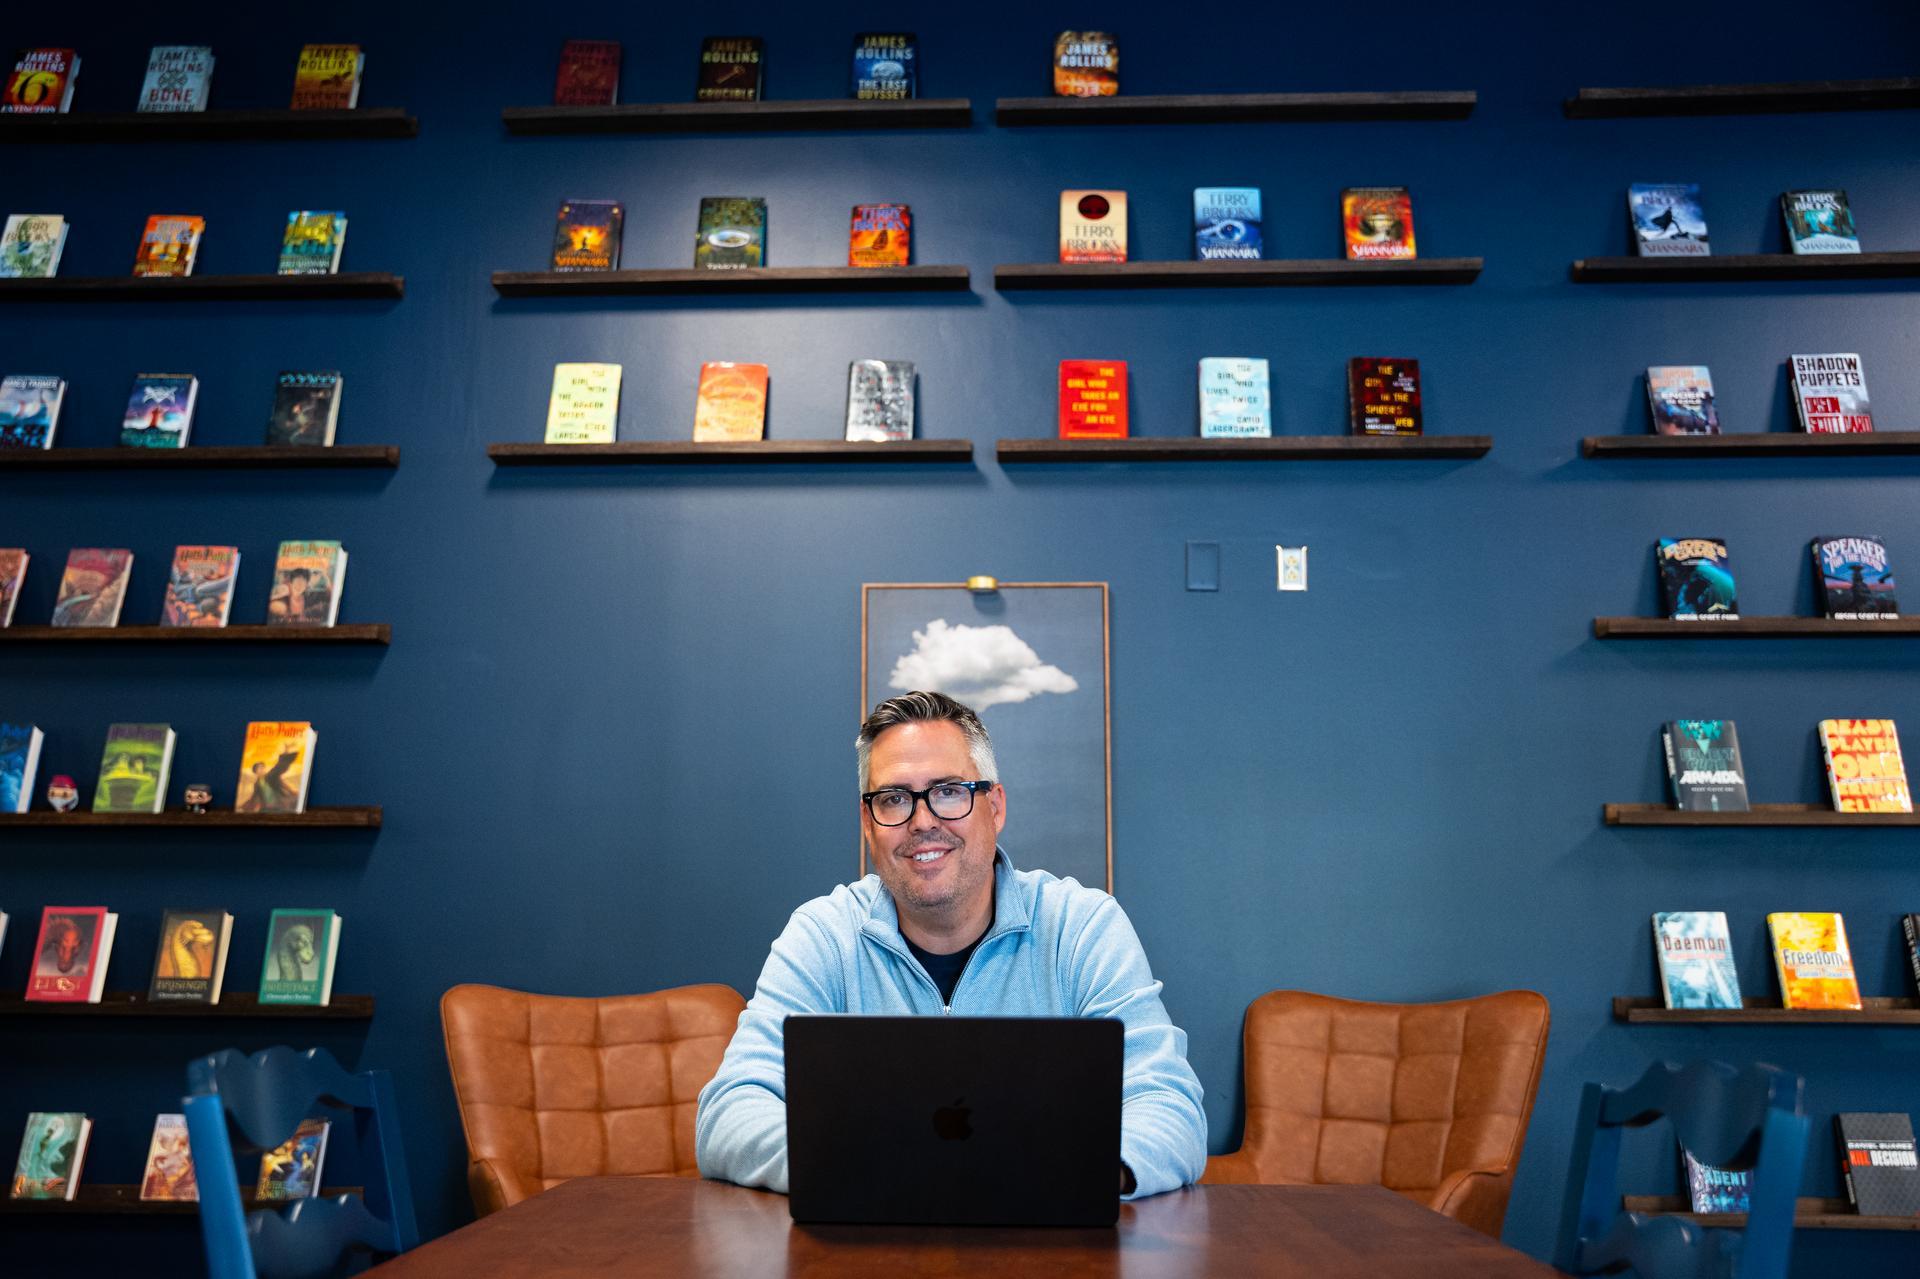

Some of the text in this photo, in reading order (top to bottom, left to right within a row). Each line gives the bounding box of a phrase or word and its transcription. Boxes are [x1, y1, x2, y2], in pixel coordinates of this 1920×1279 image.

[712, 40, 752, 51] JAMES
[864, 36, 906, 48] JAMES
[856, 48, 913, 60] ROLLINS
[1067, 43, 1107, 55] JAMES
[24, 51, 63, 62] JAMES
[160, 51, 198, 61] JAMES
[702, 51, 760, 63] ROLLINS
[1060, 55, 1112, 67] ROLLINS
[14, 61, 66, 72] ROLLINS
[149, 62, 203, 72] ROLLINS
[150, 89, 193, 103] BONE
[1209, 194, 1250, 206] TERRY
[1074, 225, 1115, 238] TERRY
[1200, 247, 1260, 259] SHANNARA
[1378, 365, 1393, 376] THE
[1796, 358, 1857, 371] SHADOW
[1099, 367, 1115, 378] THE
[1067, 378, 1108, 389] GIRL WHO
[1800, 372, 1860, 386] PUPPETS
[1393, 392, 1408, 403] THE
[1394, 417, 1414, 428] WEB
[1822, 538, 1886, 566] SPEAKER
[277, 722, 305, 738] Potter
[1828, 738, 1897, 752] PLAYER
[1831, 752, 1902, 779] ONE
[1679, 770, 1743, 784] ARMADA
[1663, 934, 1726, 951] Daemon
[1783, 949, 1844, 967] Freedom
[1704, 1171, 1747, 1187] AGENT
